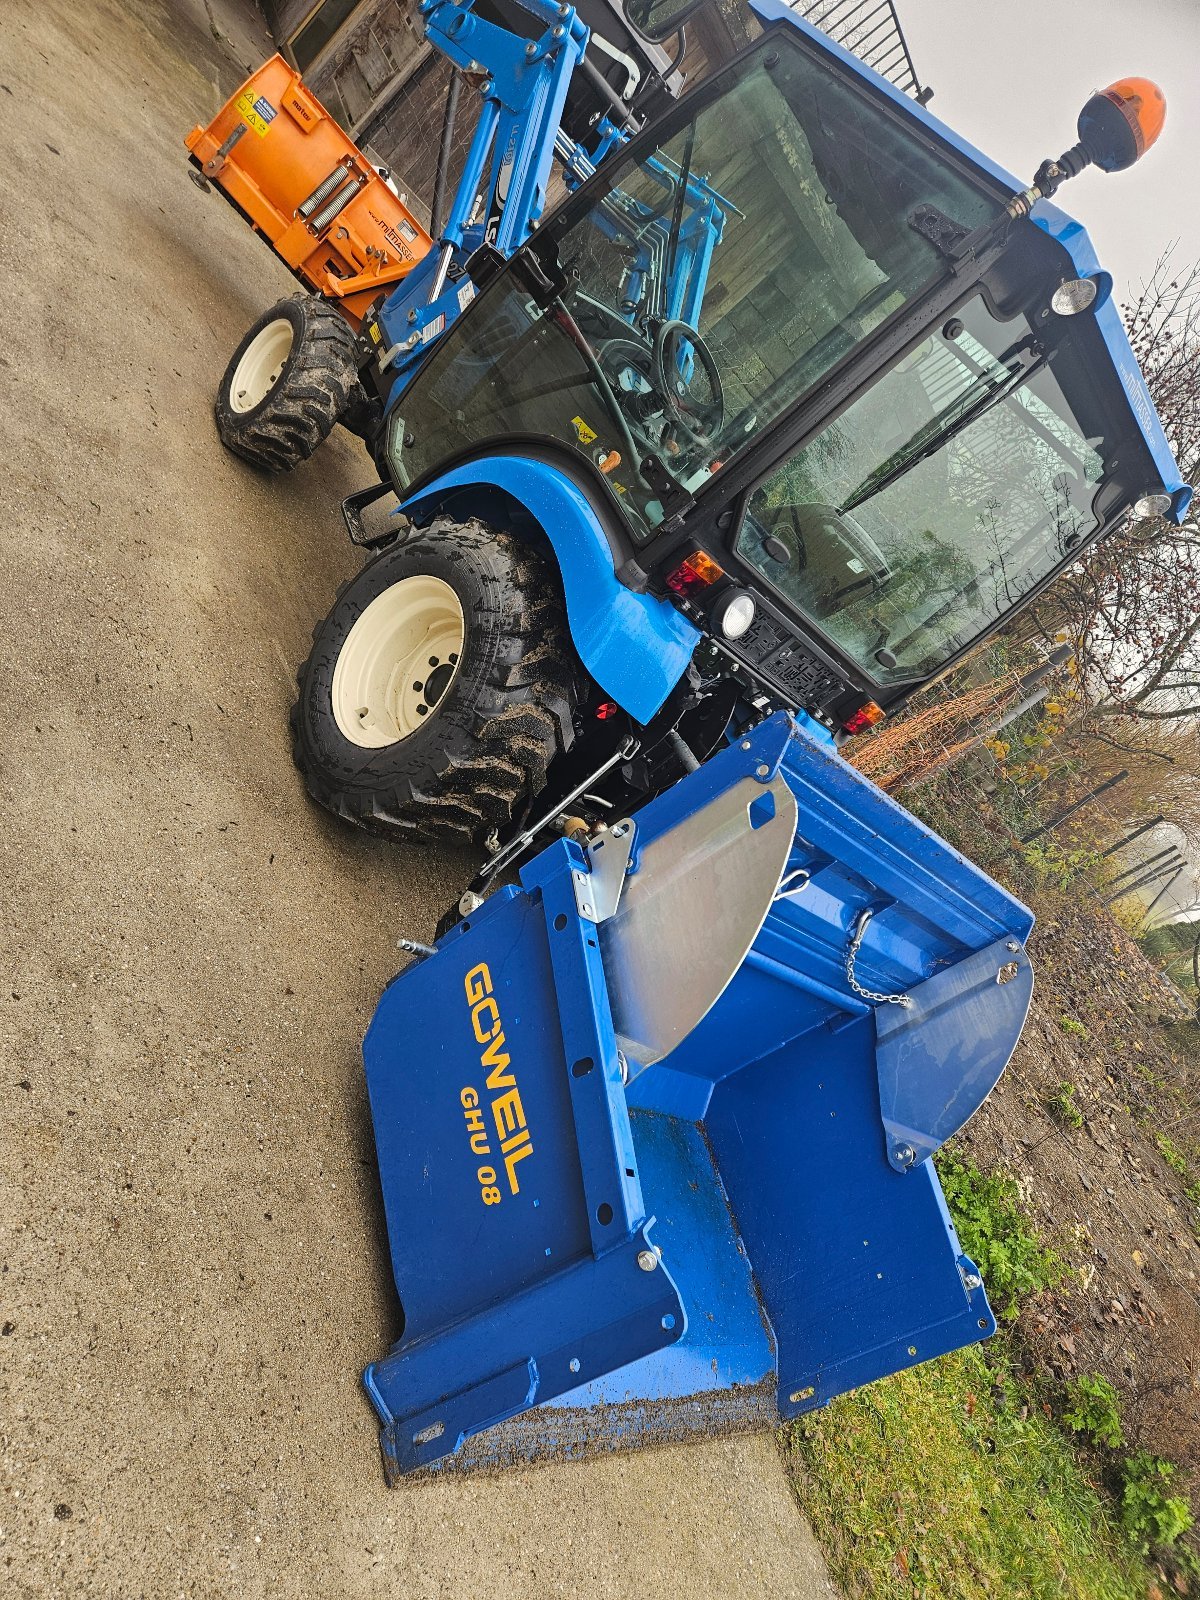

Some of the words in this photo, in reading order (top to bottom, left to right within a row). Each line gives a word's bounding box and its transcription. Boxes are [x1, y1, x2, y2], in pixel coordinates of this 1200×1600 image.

[485, 216, 500, 243] LS
[460, 1086, 491, 1155] GHU
[477, 1165, 501, 1206] 08
